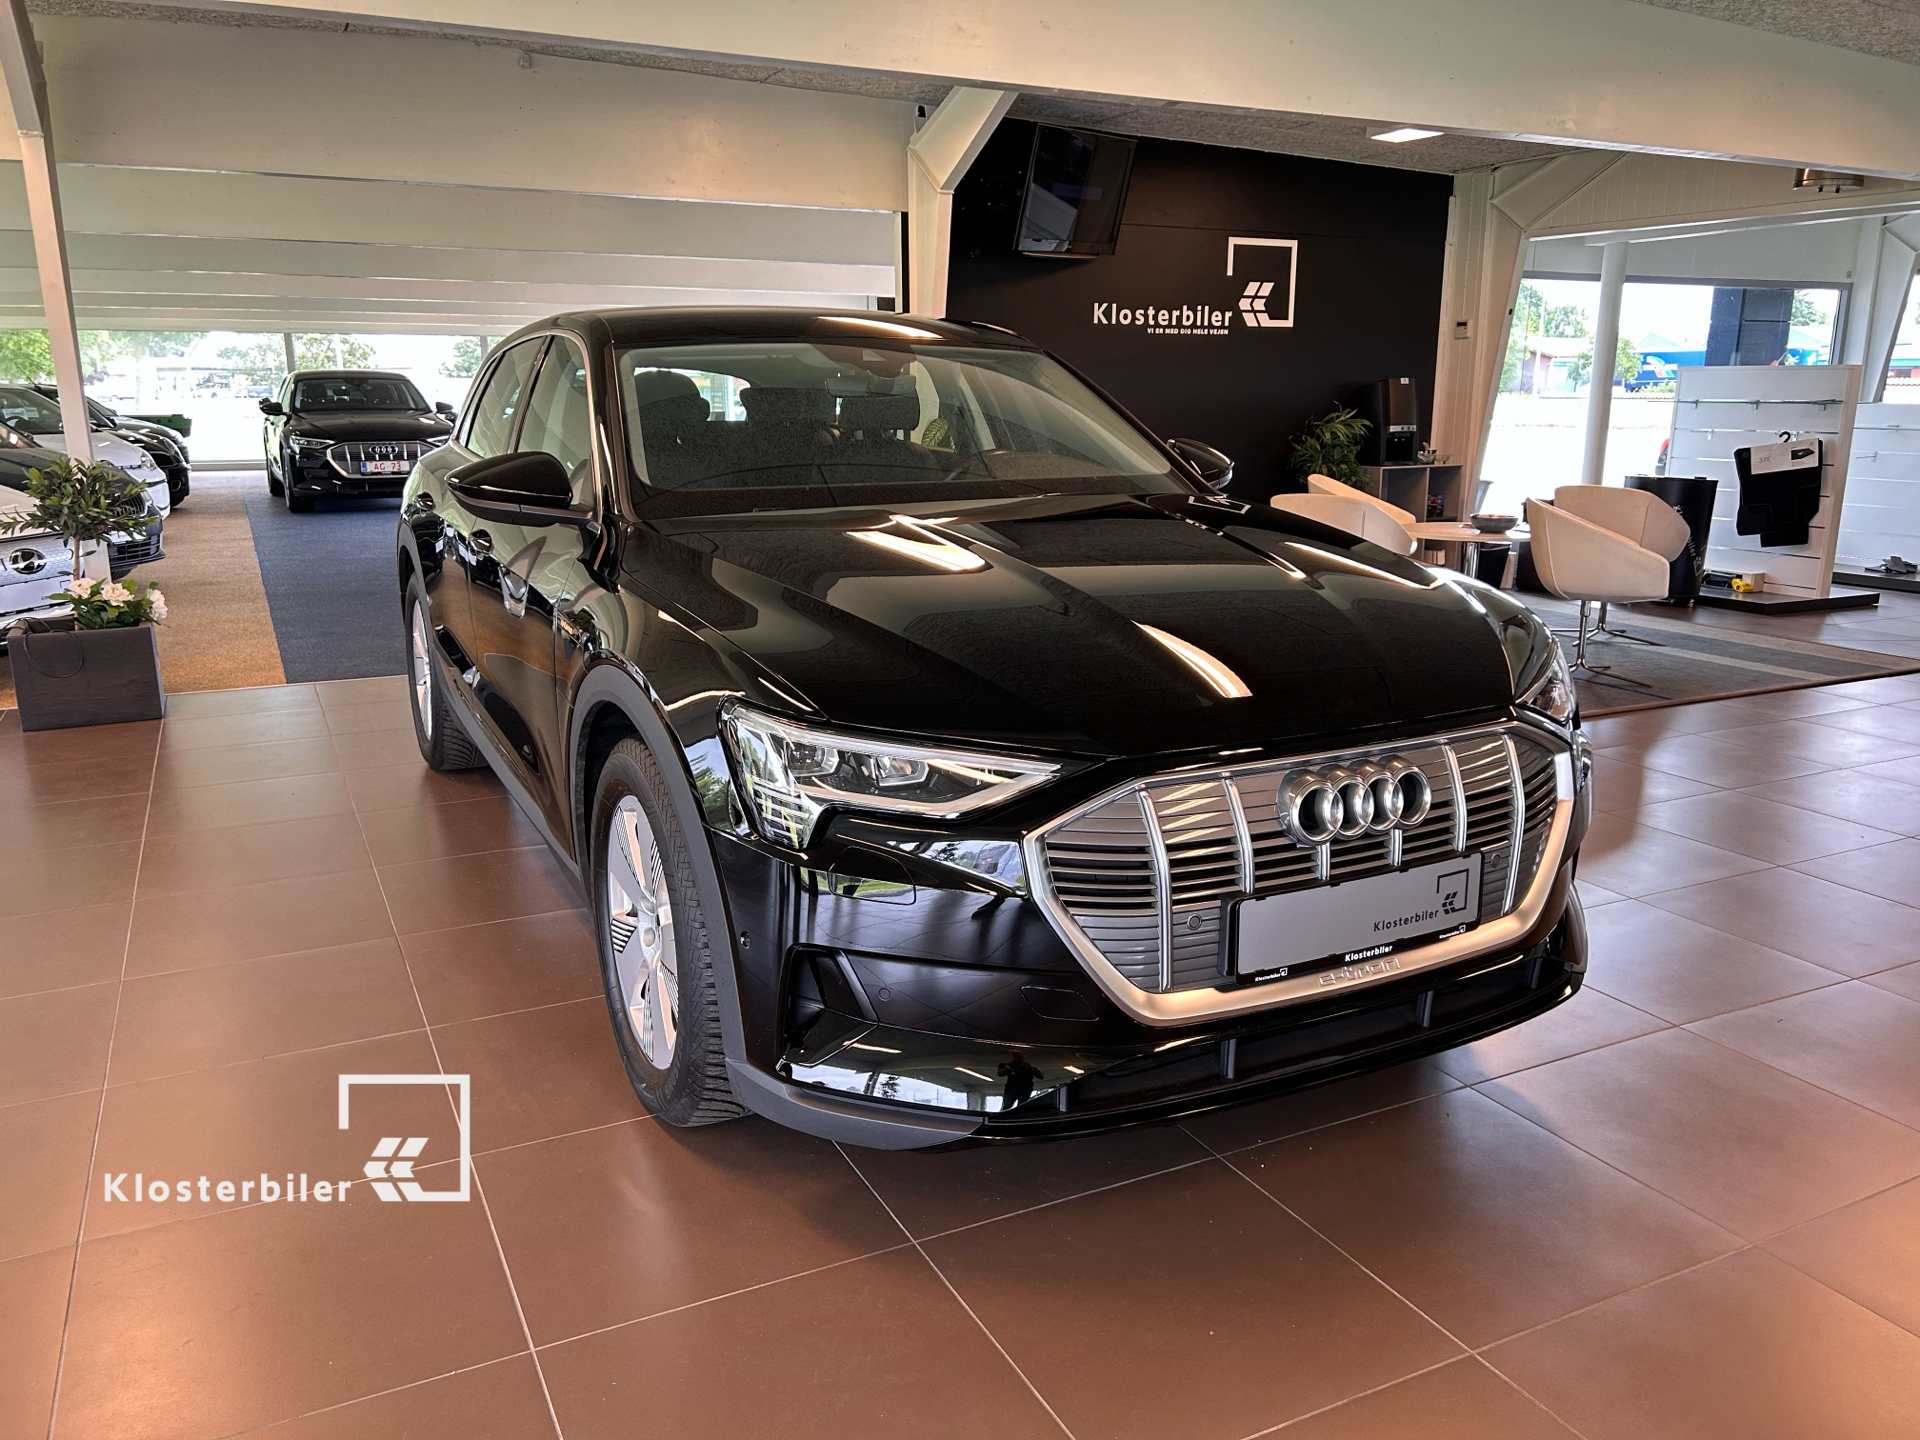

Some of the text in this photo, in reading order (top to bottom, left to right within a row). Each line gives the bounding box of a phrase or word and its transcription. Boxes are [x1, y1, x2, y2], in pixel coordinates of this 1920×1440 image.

[1093, 302, 1232, 326] Klosterbiler
[374, 462, 401, 471] AG 73
[1373, 909, 1439, 932] Klosterbiler
[1344, 945, 1393, 962] Klosterbiler
[1319, 957, 1400, 986] e-tron
